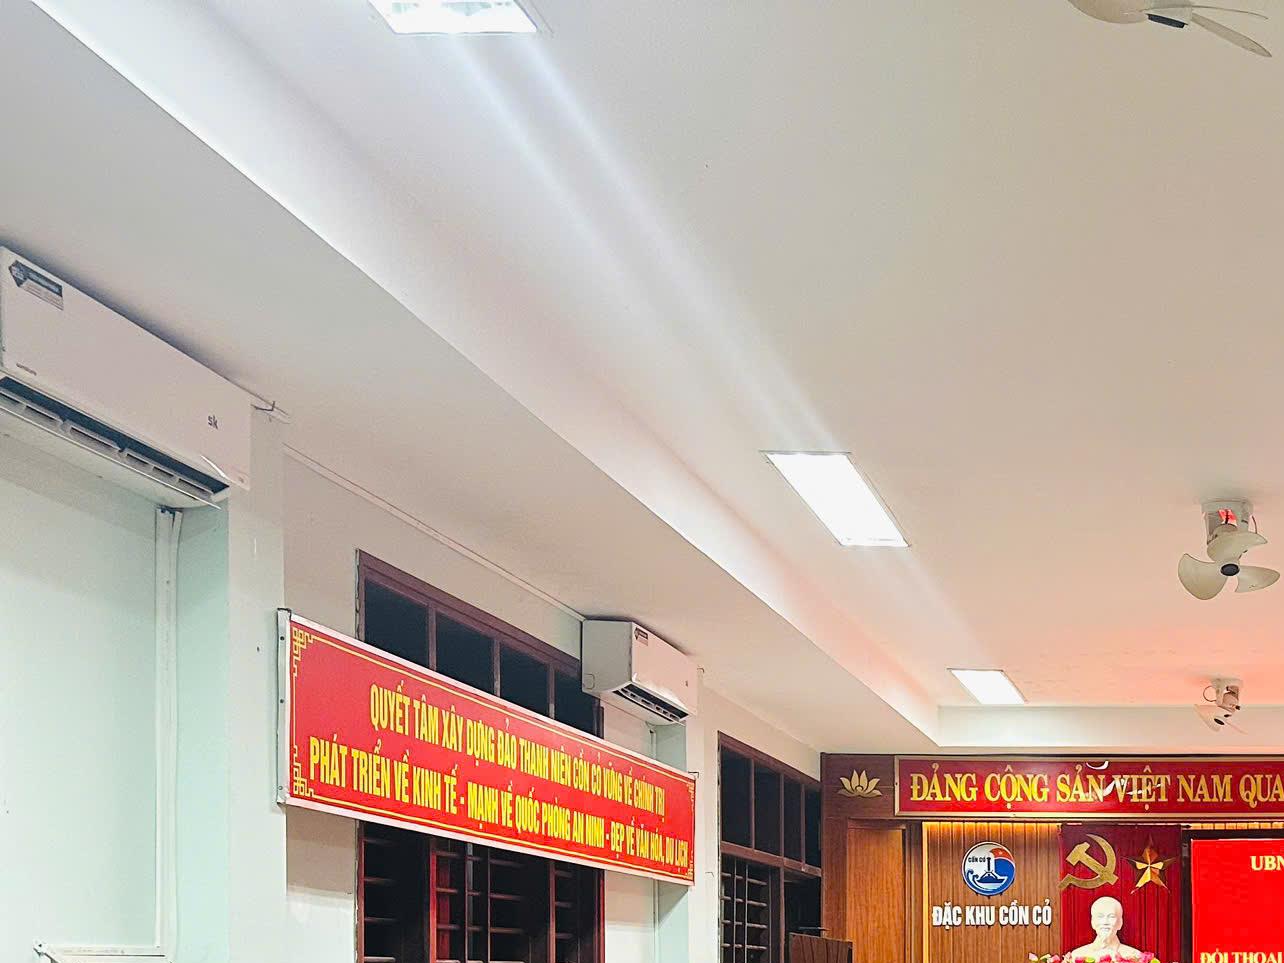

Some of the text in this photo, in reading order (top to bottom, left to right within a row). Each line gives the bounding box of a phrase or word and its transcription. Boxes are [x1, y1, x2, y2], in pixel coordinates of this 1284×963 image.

[370, 680, 665, 823] QUYẾT TÂM XÂY DỰNG ĐẢO THANH NIÊN CỒN CỎ VỮNG VỀ CHÍNH TRỊ
[910, 763, 978, 802] ĐẢNG
[984, 765, 1050, 810] CỘNG
[1056, 765, 1104, 802] SẢN
[1111, 765, 1171, 811] VIỆT
[1177, 774, 1233, 802] NAM
[309, 733, 347, 788] PHÁT
[351, 738, 390, 799] TRIỂN
[394, 749, 410, 804] VỀ
[413, 765, 441, 811] KINH
[444, 764, 458, 815] TẾ
[467, 781, 499, 830] MẠNH
[500, 780, 513, 828] VỀ
[515, 786, 540, 834] QUỐC
[542, 797, 571, 841] PHÒNG
[572, 810, 584, 845] AN
[585, 814, 605, 849] NINH
[610, 821, 625, 859] ĐẸP
[625, 816, 635, 856] VỀ
[636, 823, 650, 859] VĂN
[666, 836, 675, 865] DU
[932, 899, 1052, 930] ĐẶC KHU CỒN CỎ
